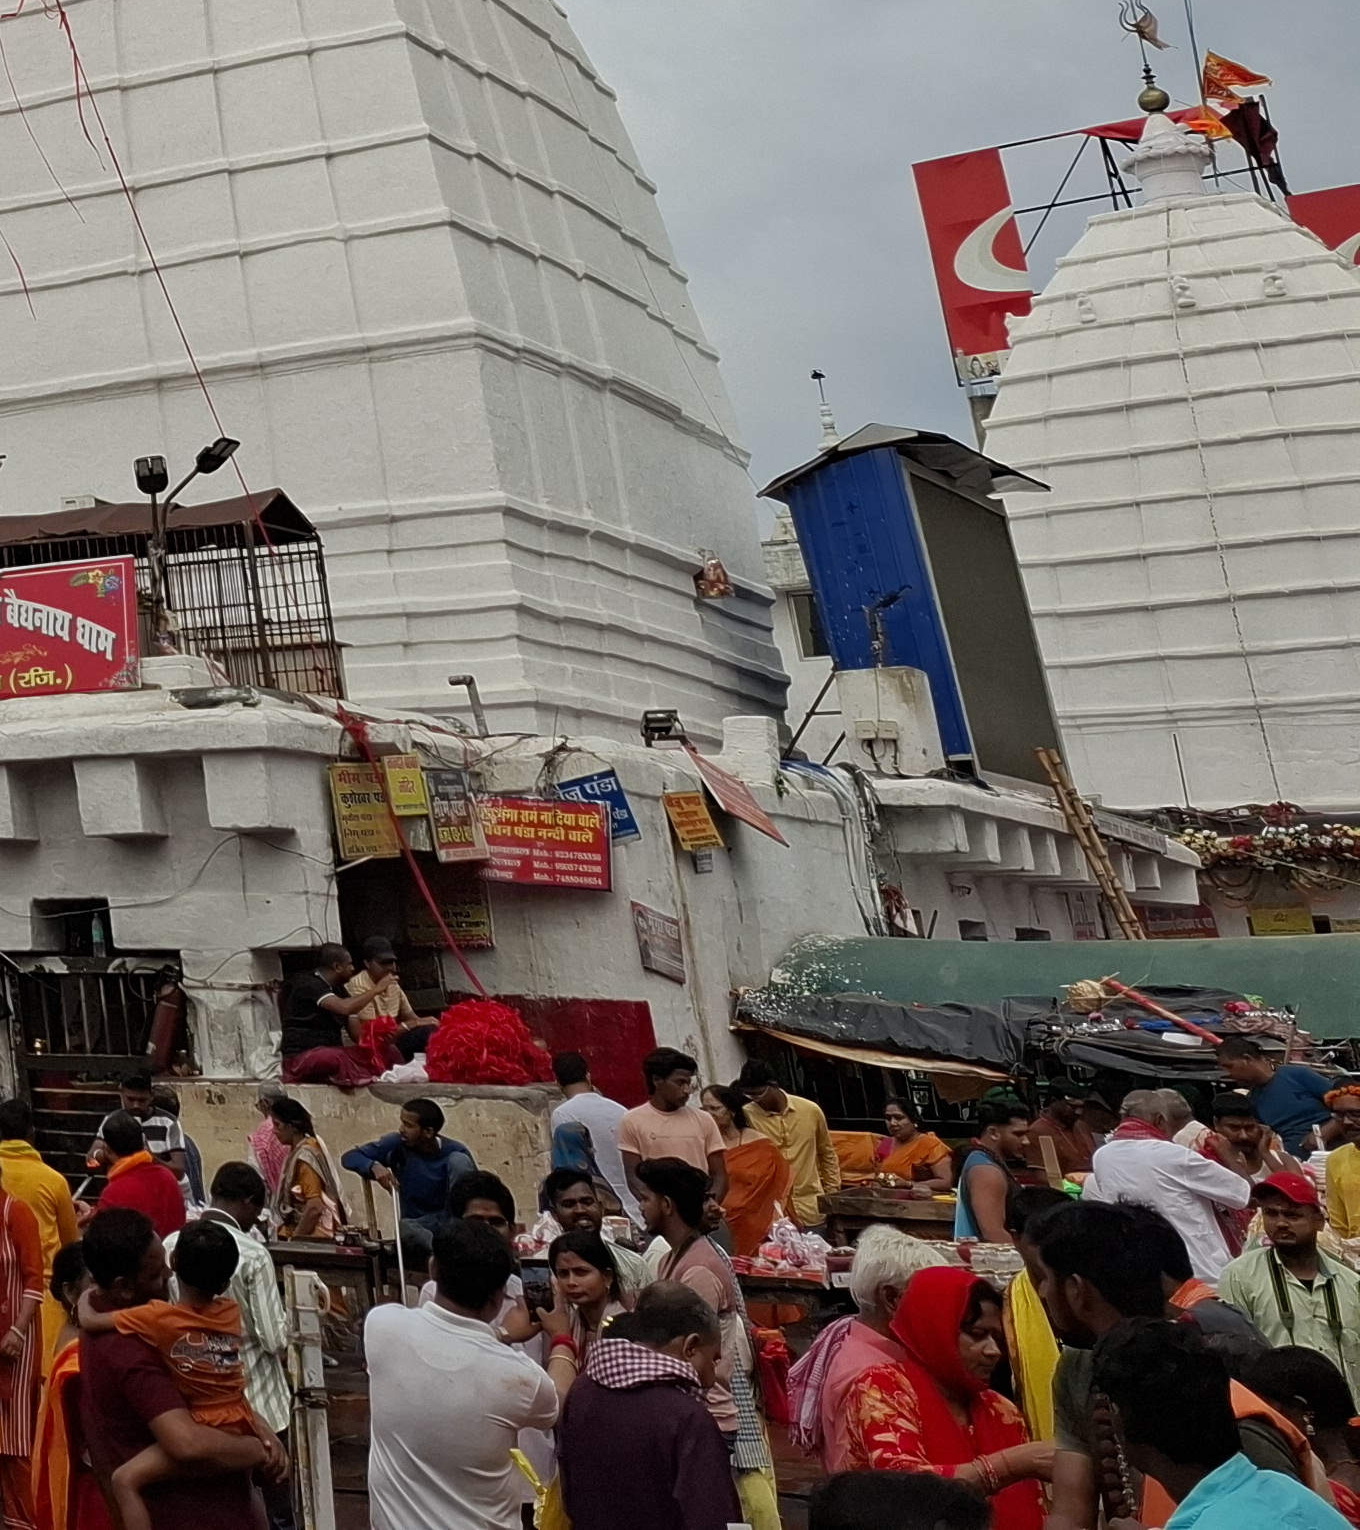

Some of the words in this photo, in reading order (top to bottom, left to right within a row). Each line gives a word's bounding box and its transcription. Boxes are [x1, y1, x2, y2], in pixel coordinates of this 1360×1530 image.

[3, 588, 73, 642] बैद्यनाथ
[76, 616, 116, 661] धाम
[337, 770, 361, 785] भीम
[583, 775, 618, 796] पंडा
[514, 824, 535, 839] पंडा
